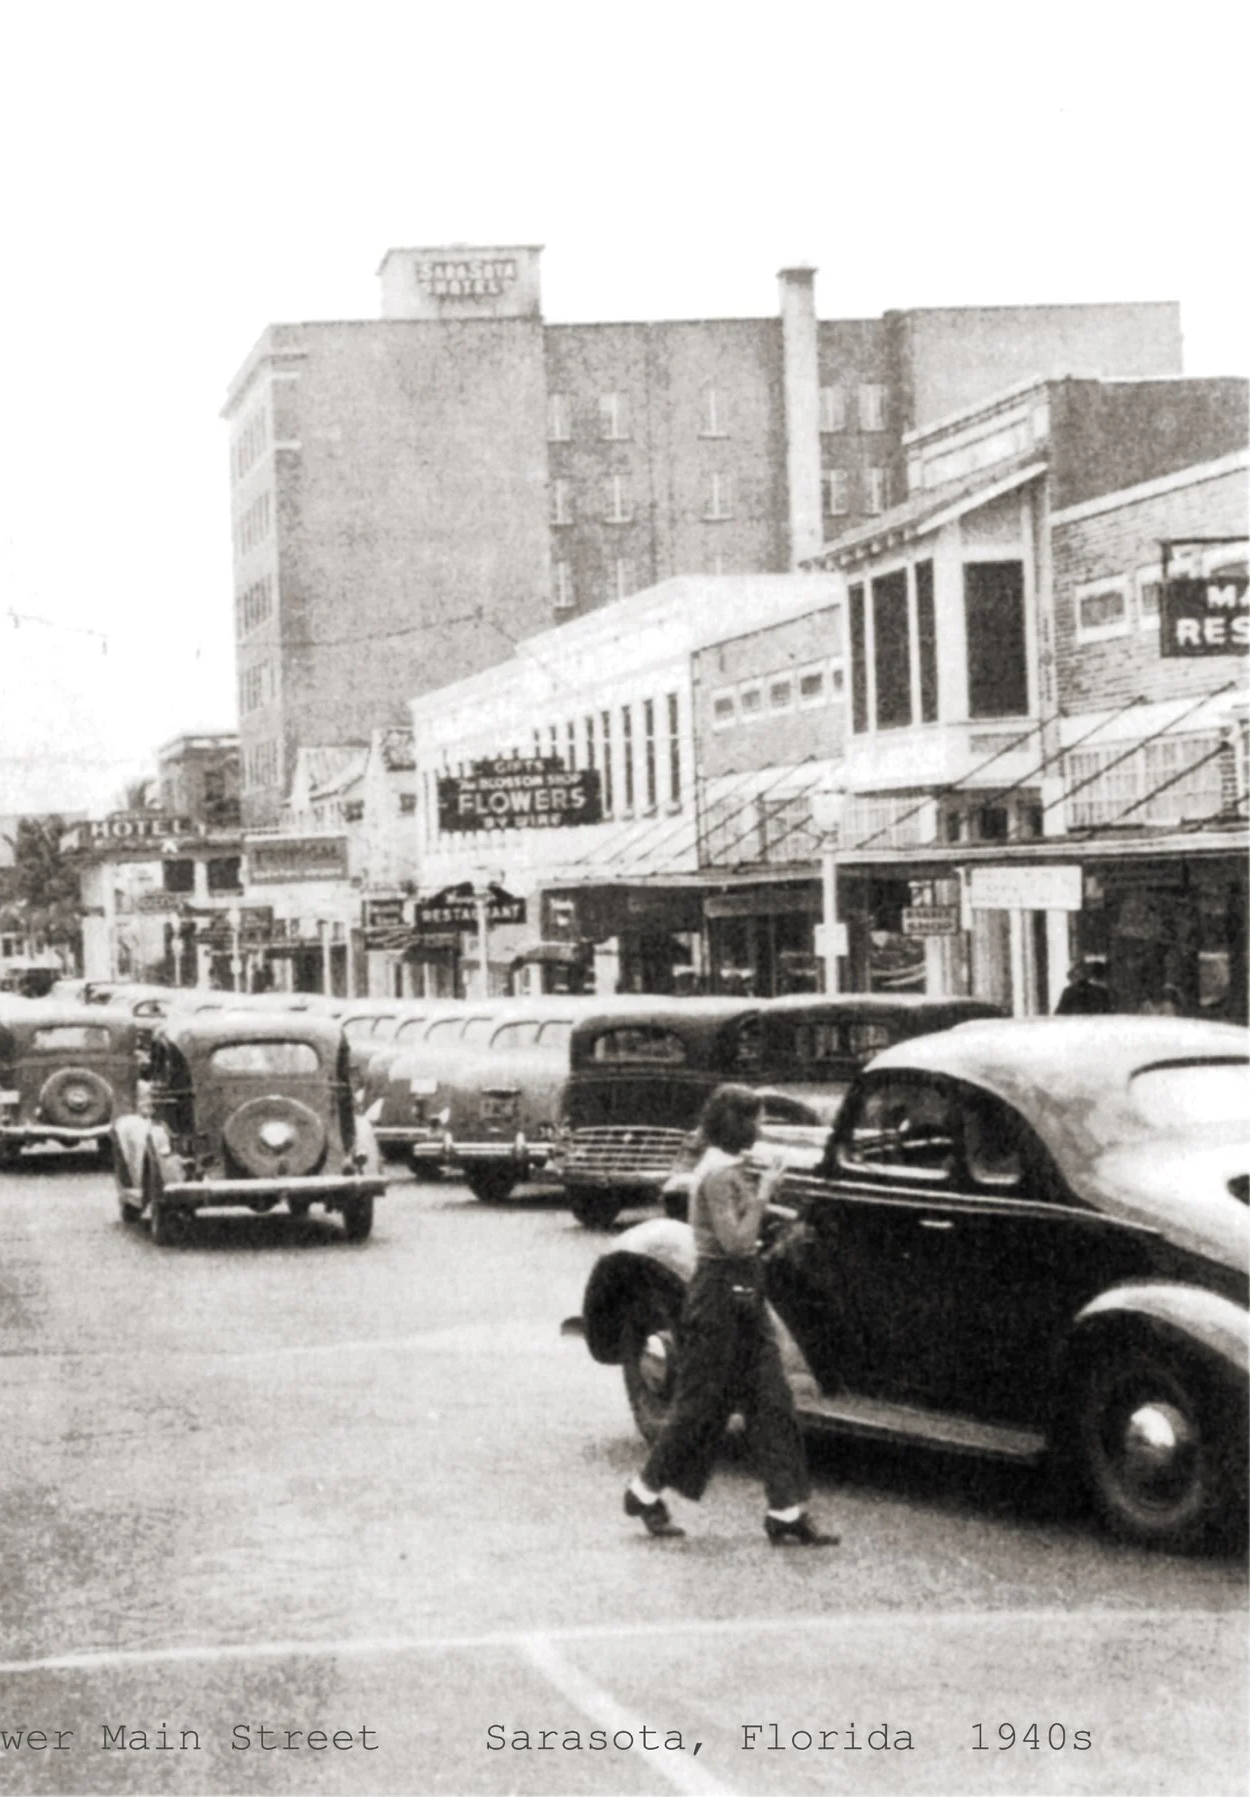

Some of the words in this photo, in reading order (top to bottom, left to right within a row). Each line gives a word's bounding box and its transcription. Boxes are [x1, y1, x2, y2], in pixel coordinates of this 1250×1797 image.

[494, 760, 545, 774] GIFTS
[458, 787, 587, 816] FLOWERS
[91, 819, 185, 838] HOTEL
